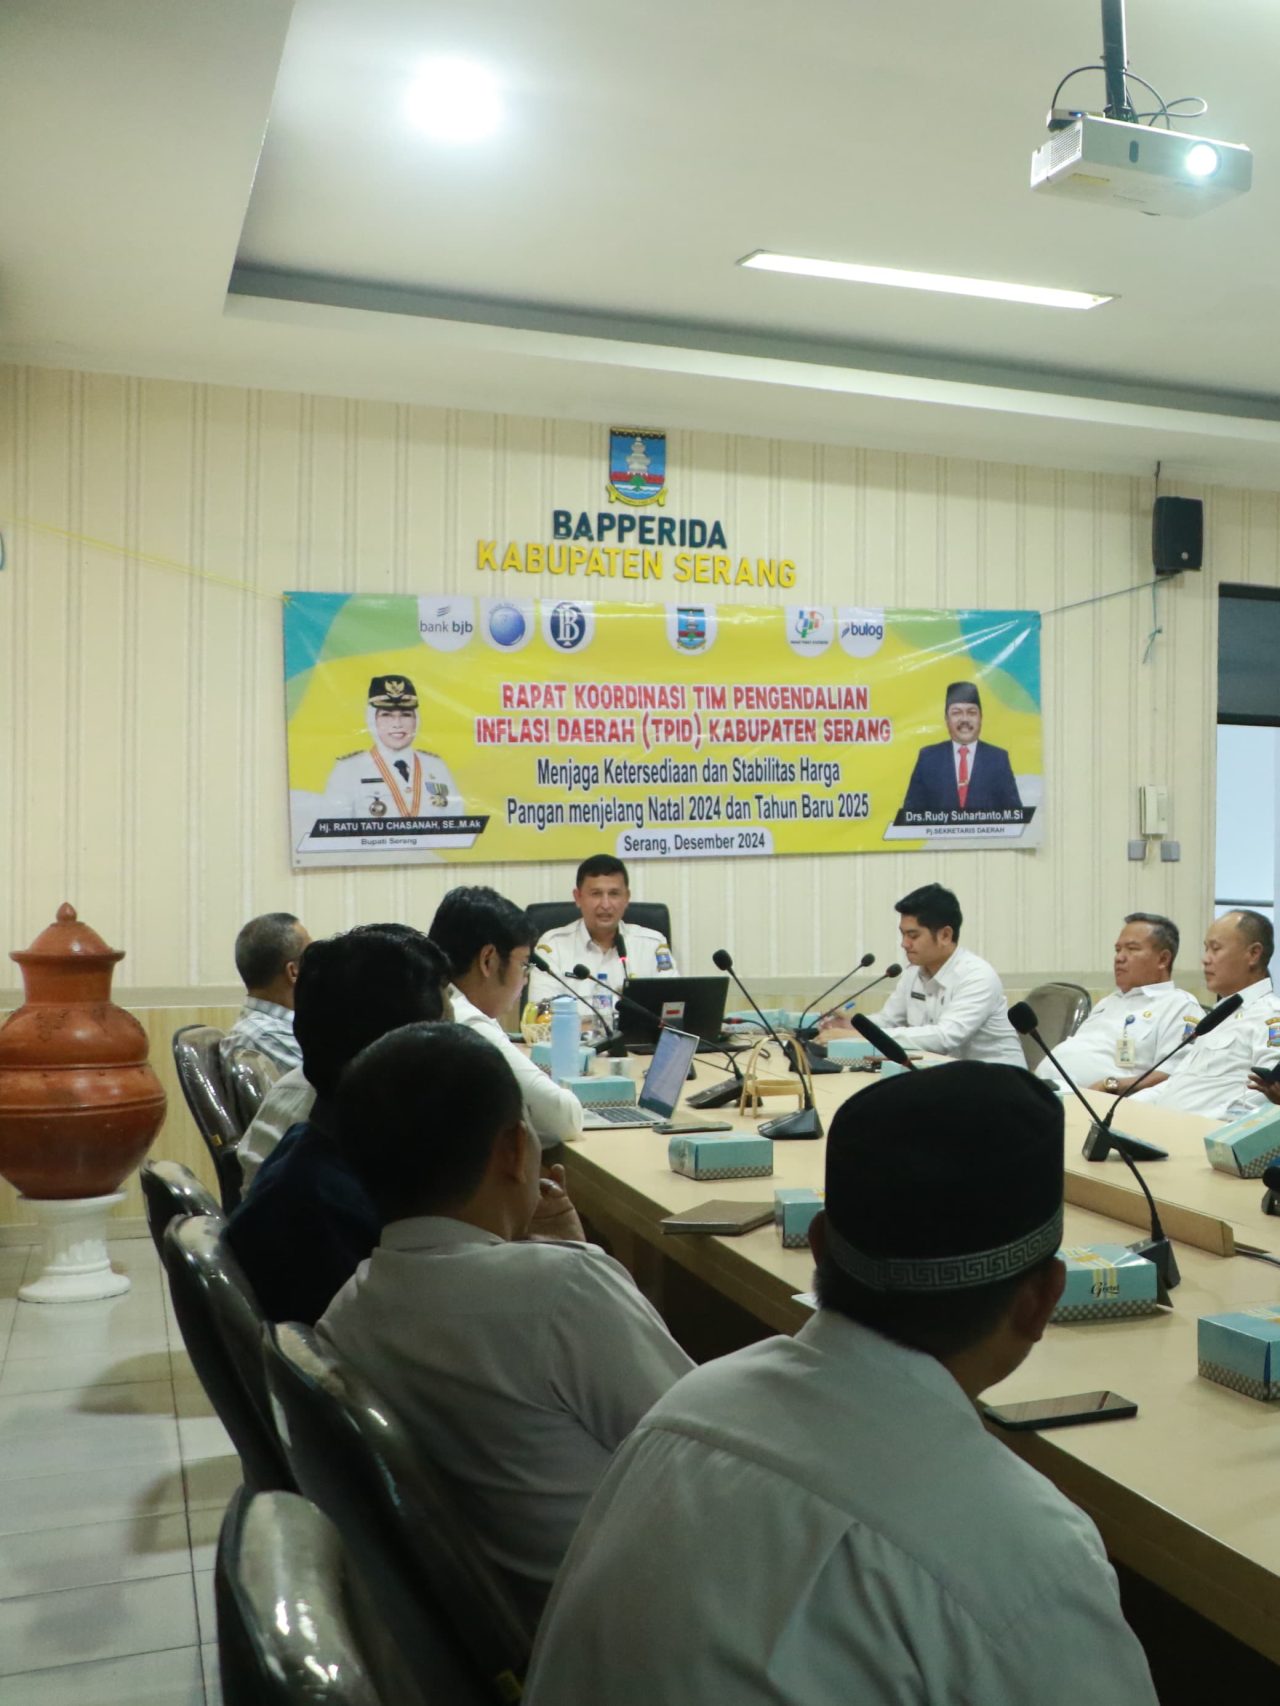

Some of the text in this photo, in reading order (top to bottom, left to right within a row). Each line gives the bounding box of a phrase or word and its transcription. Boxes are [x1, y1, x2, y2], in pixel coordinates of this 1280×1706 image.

[552, 510, 727, 549] BAPPERIDA
[476, 540, 797, 588] KABUPATEN SERANG
[419, 620, 473, 635] bank bjb
[851, 622, 883, 640] bulog
[502, 684, 868, 710] RAPAT KOORDINASI TIM PENGENDALIAN
[476, 711, 891, 750] INFLASI DAERAH (TPID) KABUPATEN SERANG
[537, 757, 840, 791] Menjaga Ketersediaan dan Stabilitas Harga
[508, 793, 869, 831] Pangan menjelang Natal 2024 dan Tahun Baru 2025
[905, 811, 949, 824] Drs.Rudy
[333, 823, 359, 831] RATU
[361, 822, 384, 831] TATU
[361, 837, 417, 846] Bupati Serang
[624, 832, 765, 855] Serang, Desember 2024
